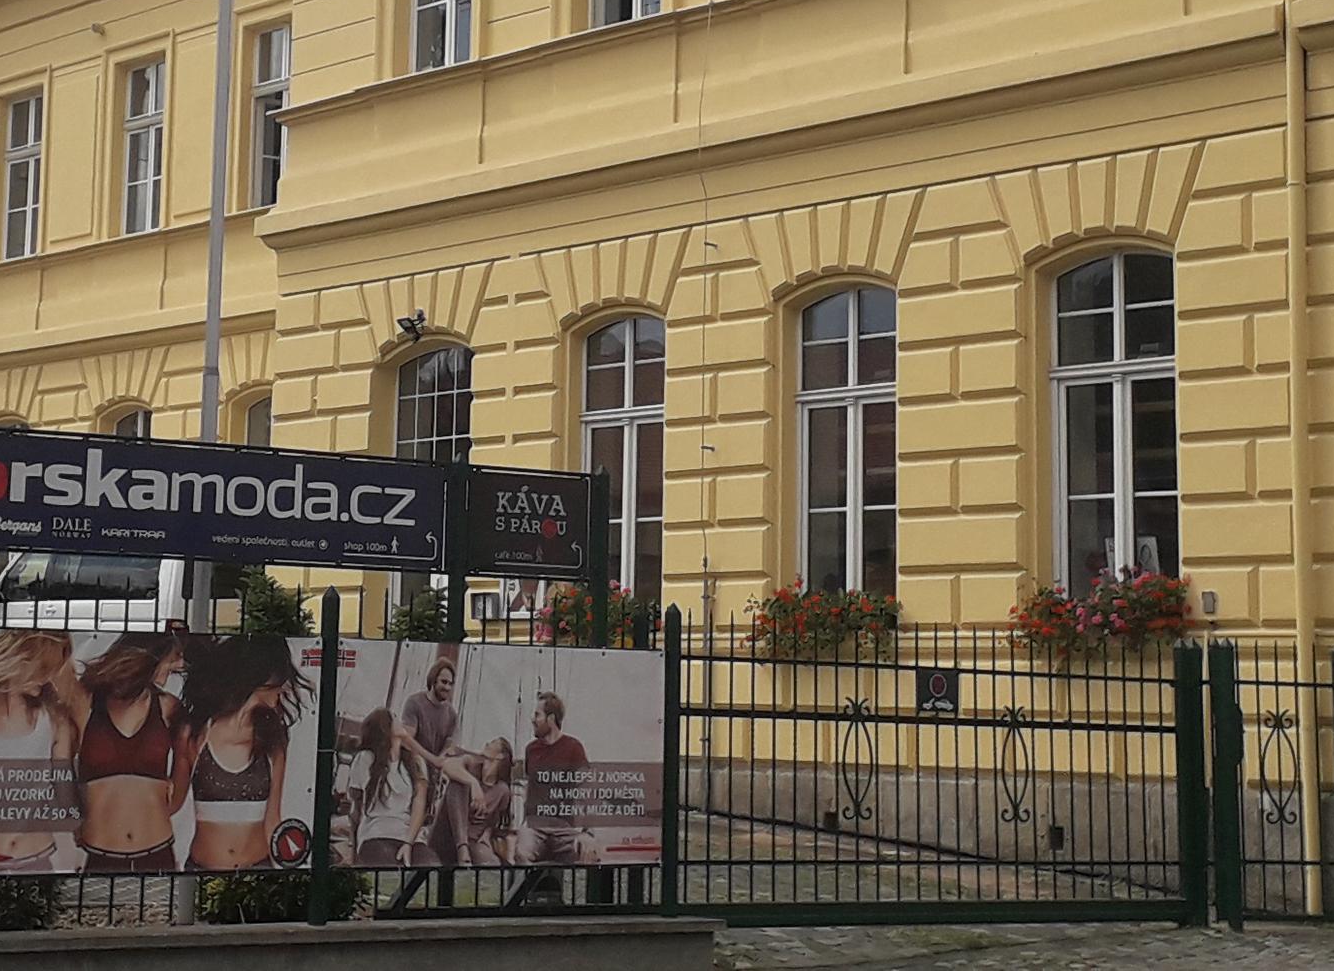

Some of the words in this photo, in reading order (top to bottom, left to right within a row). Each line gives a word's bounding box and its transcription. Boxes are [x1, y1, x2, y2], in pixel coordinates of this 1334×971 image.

[496, 485, 567, 517] KÁVA
[51, 516, 92, 531] DALE
[495, 516, 506, 531] S
[343, 540, 364, 552] shop
[7, 769, 73, 782] PRODEJNA
[537, 770, 549, 783] TO
[551, 769, 596, 783] NEJLEPŠÍ
[597, 771, 604, 783] Z
[605, 771, 646, 783] NORSKA
[549, 788, 563, 799] NA
[565, 788, 591, 799] HORY
[599, 788, 612, 799] DO
[614, 785, 645, 800] MĚSTA
[33, 804, 49, 819] AŽ
[51, 808, 67, 821] 50
[68, 807, 81, 821] %
[537, 804, 557, 816] PRO
[615, 805, 622, 816] A
[624, 802, 645, 816] DĚTI
